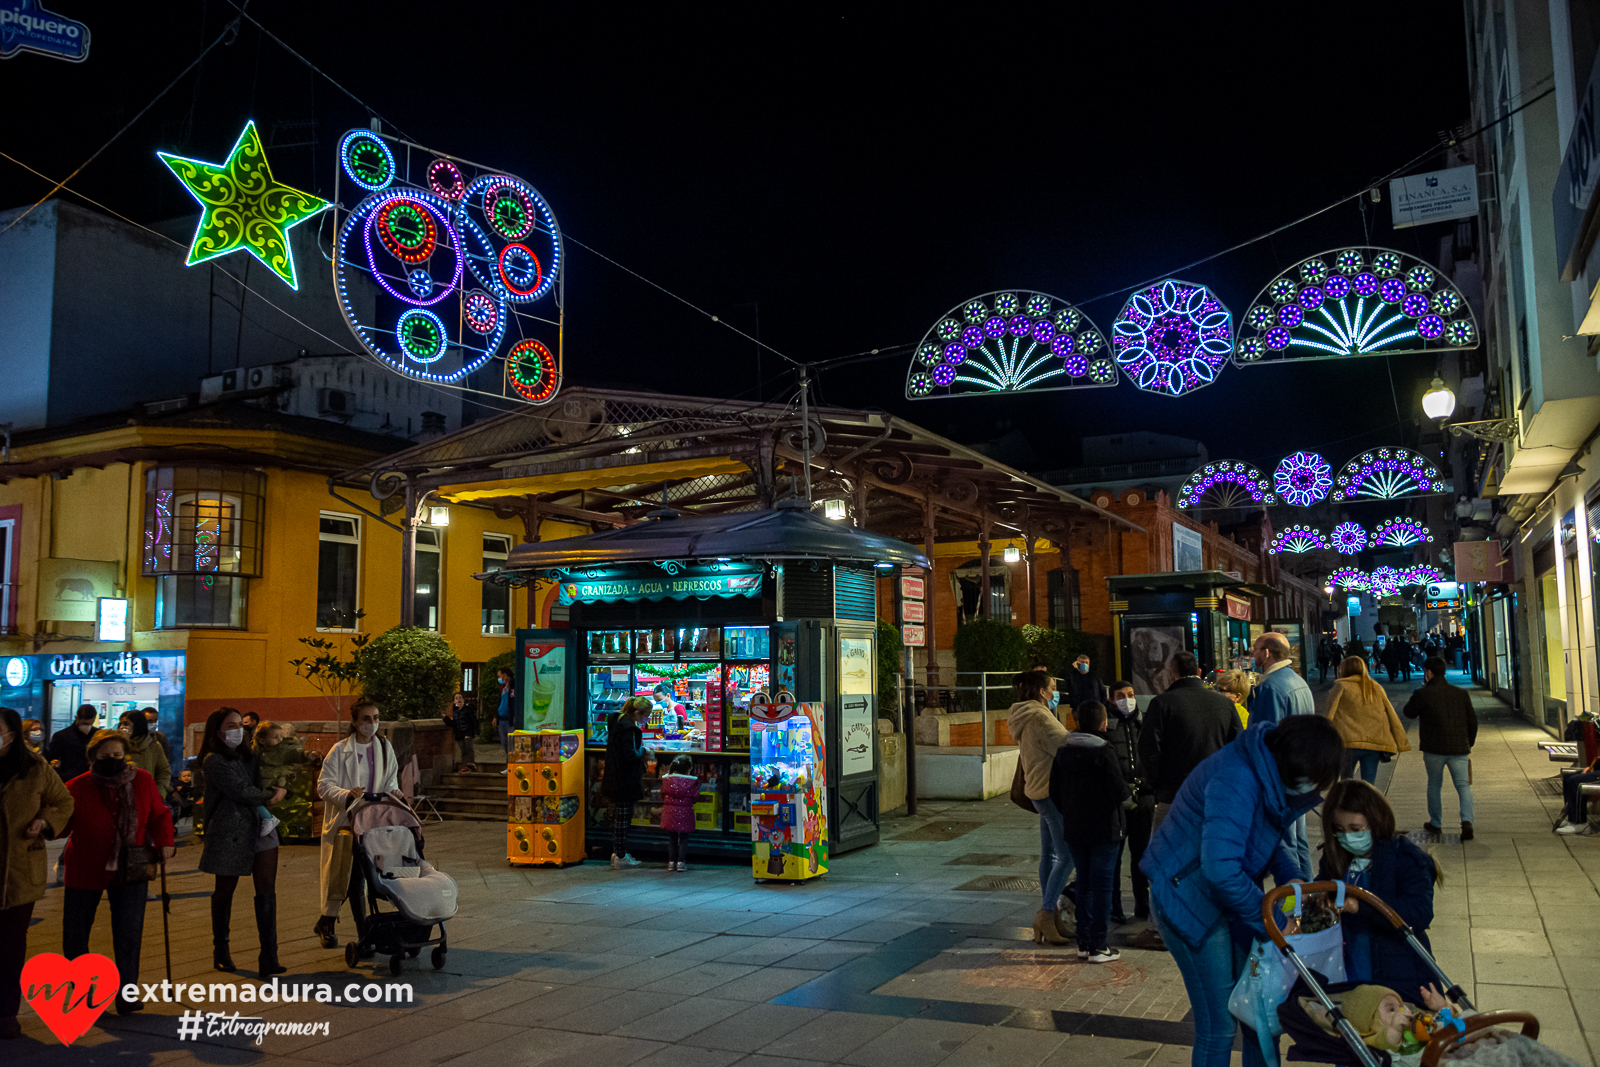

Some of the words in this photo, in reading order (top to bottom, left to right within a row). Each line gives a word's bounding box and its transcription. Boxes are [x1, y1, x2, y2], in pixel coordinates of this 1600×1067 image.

[1433, 196, 1471, 206] PERSONALES
[1421, 204, 1452, 213] HIPOTECAS
[582, 583, 629, 596] GRANIZADA
[638, 582, 663, 594] AGUA
[672, 579, 722, 592] REFRESCOS
[51, 652, 145, 678] Ortopedia
